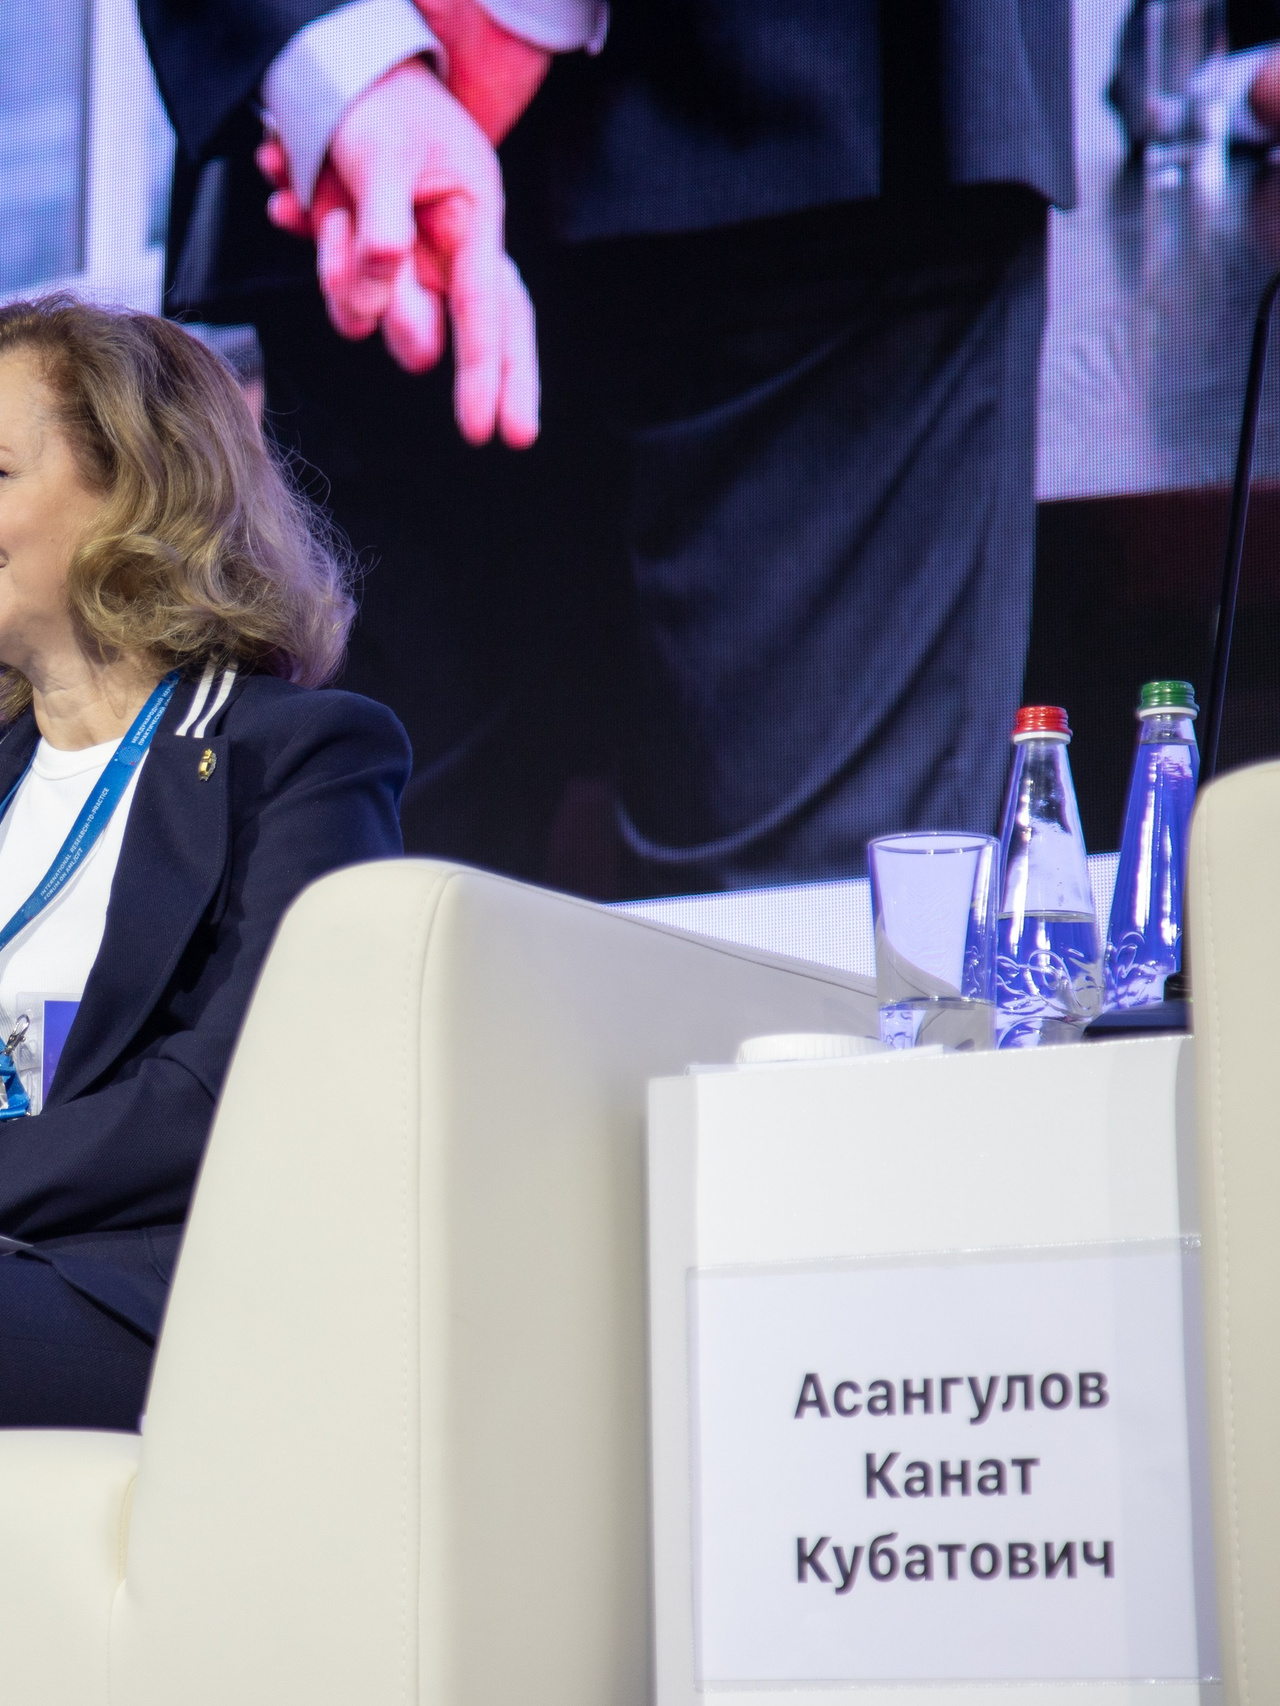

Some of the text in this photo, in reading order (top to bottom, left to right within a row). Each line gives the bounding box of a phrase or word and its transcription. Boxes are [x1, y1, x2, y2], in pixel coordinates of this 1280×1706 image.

[131, 697, 165, 744] МЕЖДУНАРОДНЫЙ
[138, 706, 166, 746] ПРАКТИЧЕСКИЙ
[40, 786, 110, 897] INTERNATIONAL RESEARCH-TO-PRACTICE
[43, 847, 84, 901] FORUM ON AML/CFT
[794, 1371, 1109, 1425] Асангулов
[865, 1452, 1040, 1498] Канат
[796, 1532, 1115, 1595] Кубатович
